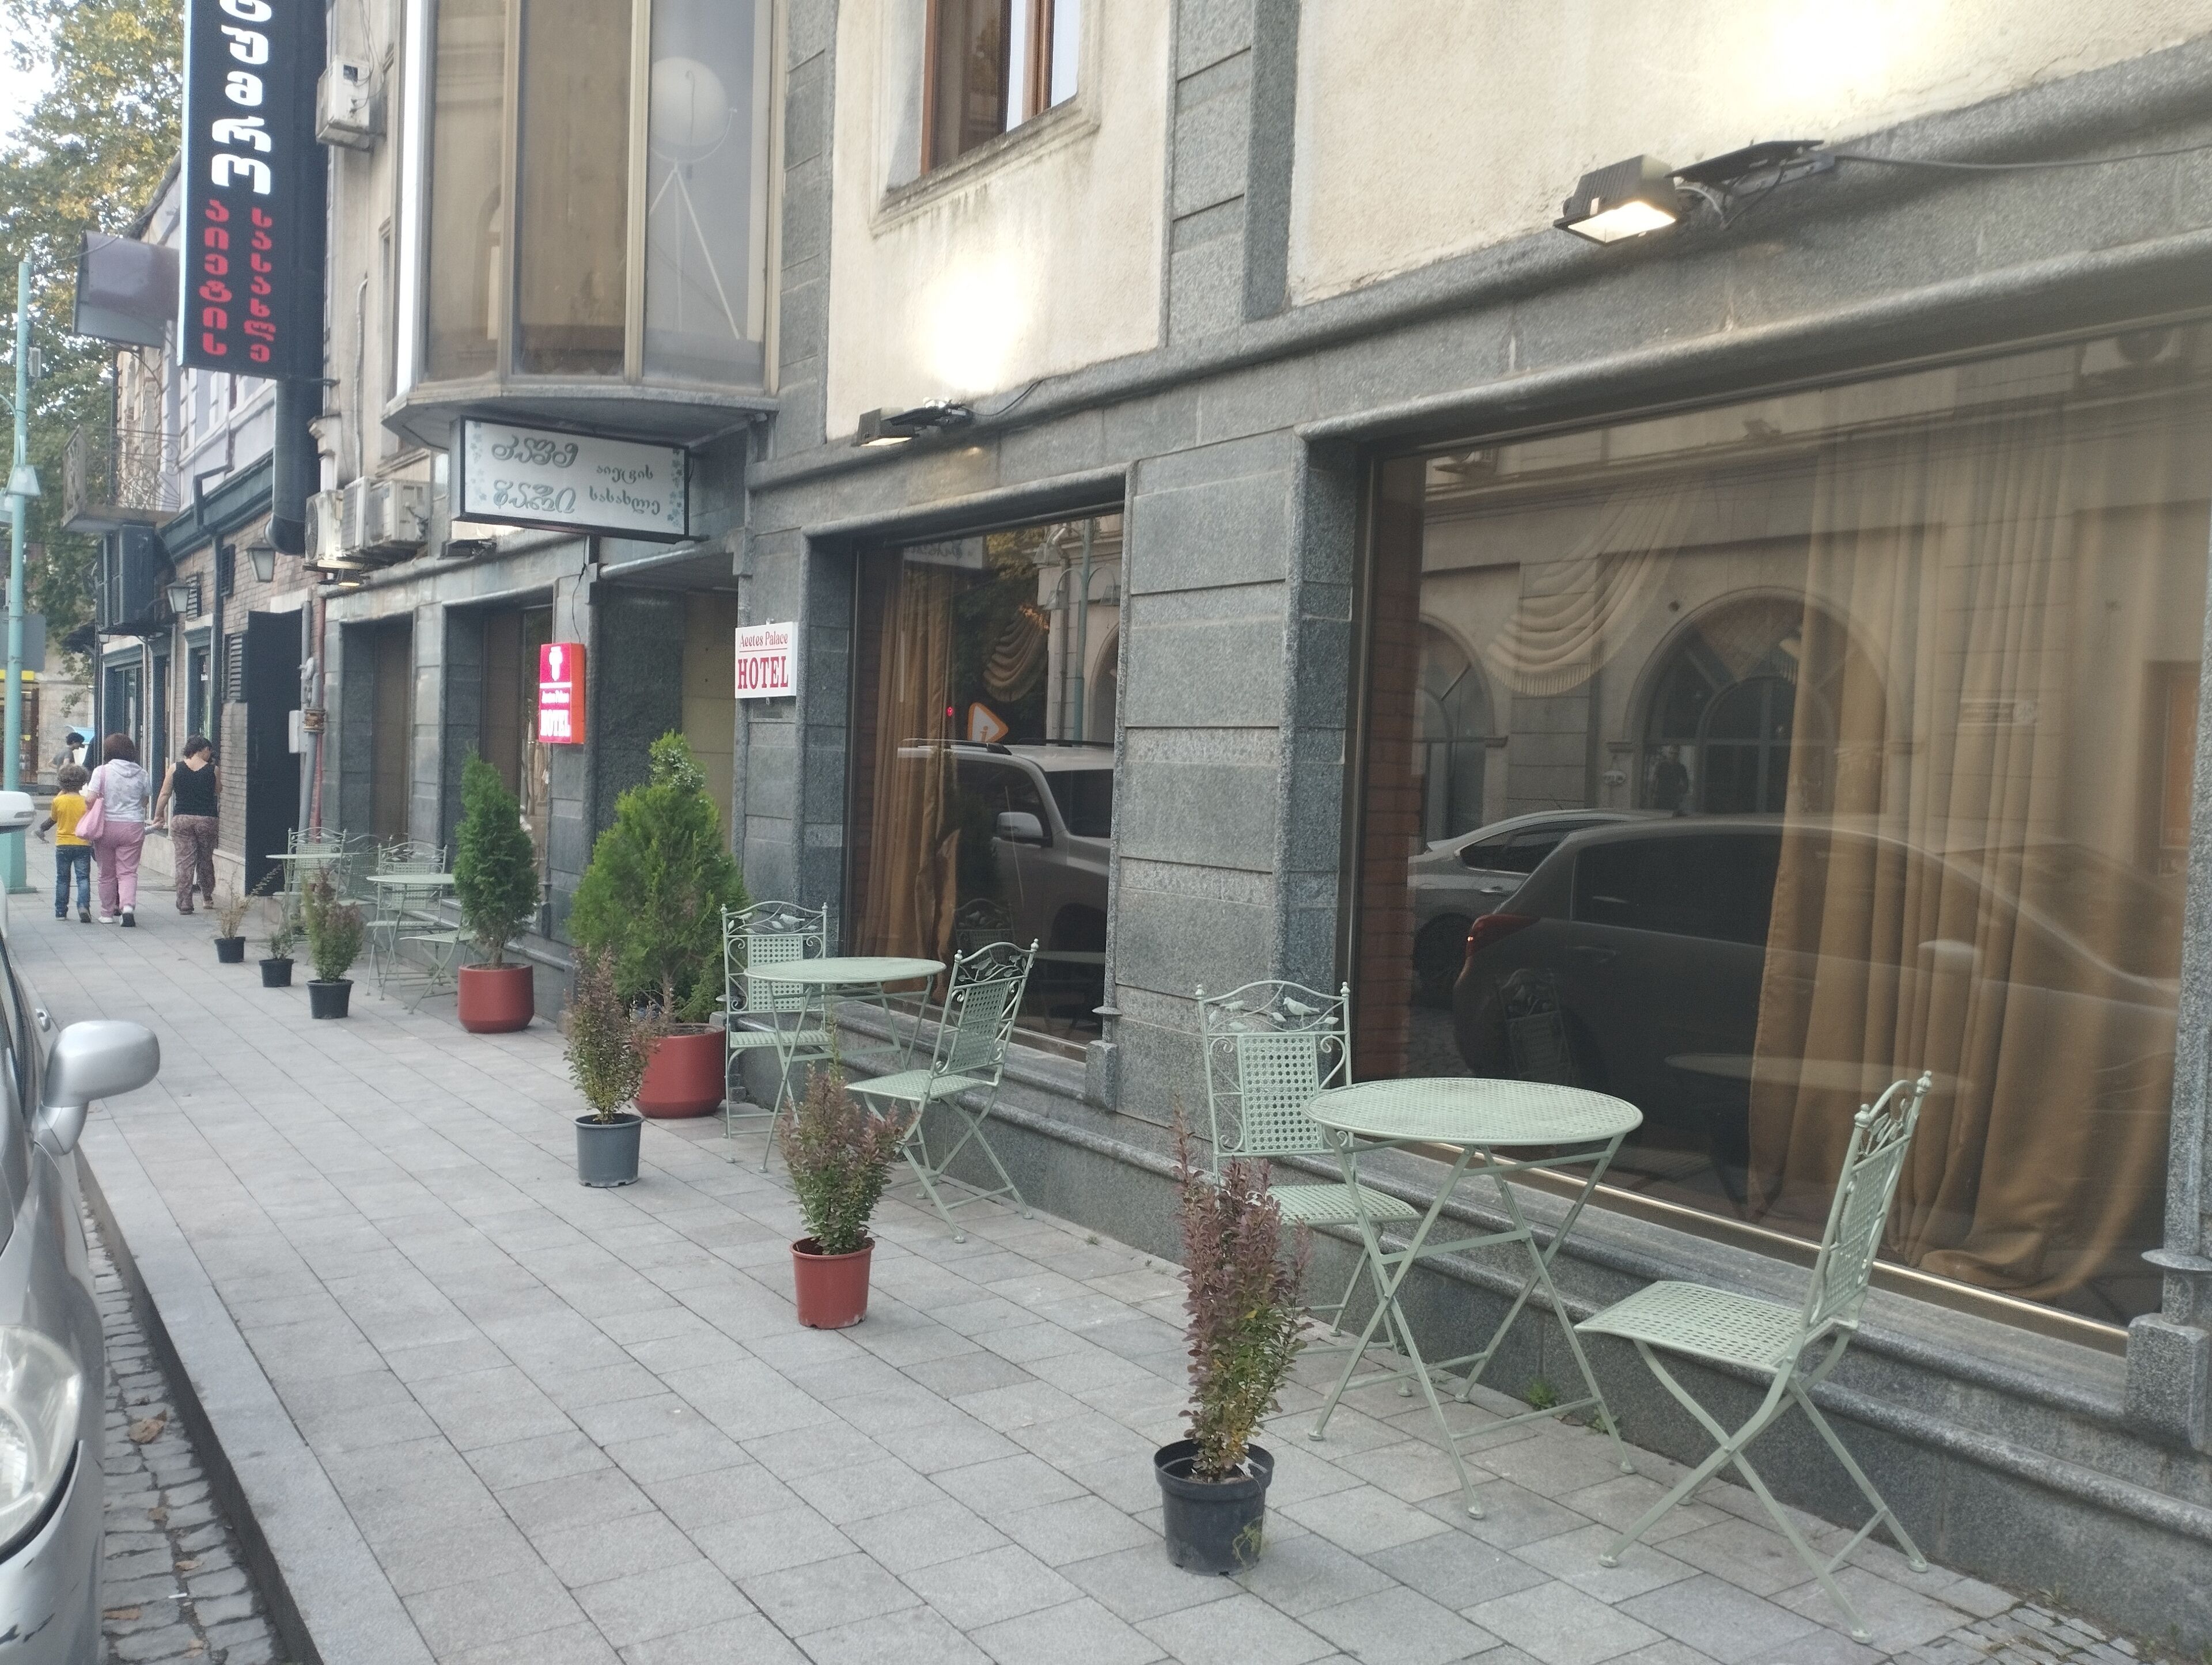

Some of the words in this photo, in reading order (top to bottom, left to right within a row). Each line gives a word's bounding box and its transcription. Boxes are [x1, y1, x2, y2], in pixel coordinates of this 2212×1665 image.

[199, 199, 232, 355] აიეტის
[244, 207, 276, 363] სასახლე
[491, 434, 578, 468] კაფე
[596, 464, 653, 484] აიეტის
[493, 479, 577, 514] ბარი
[589, 485, 660, 515] სასახლე
[740, 633, 763, 647] Aeetes
[765, 631, 788, 646] Palace
[737, 656, 789, 689] HOTEL
